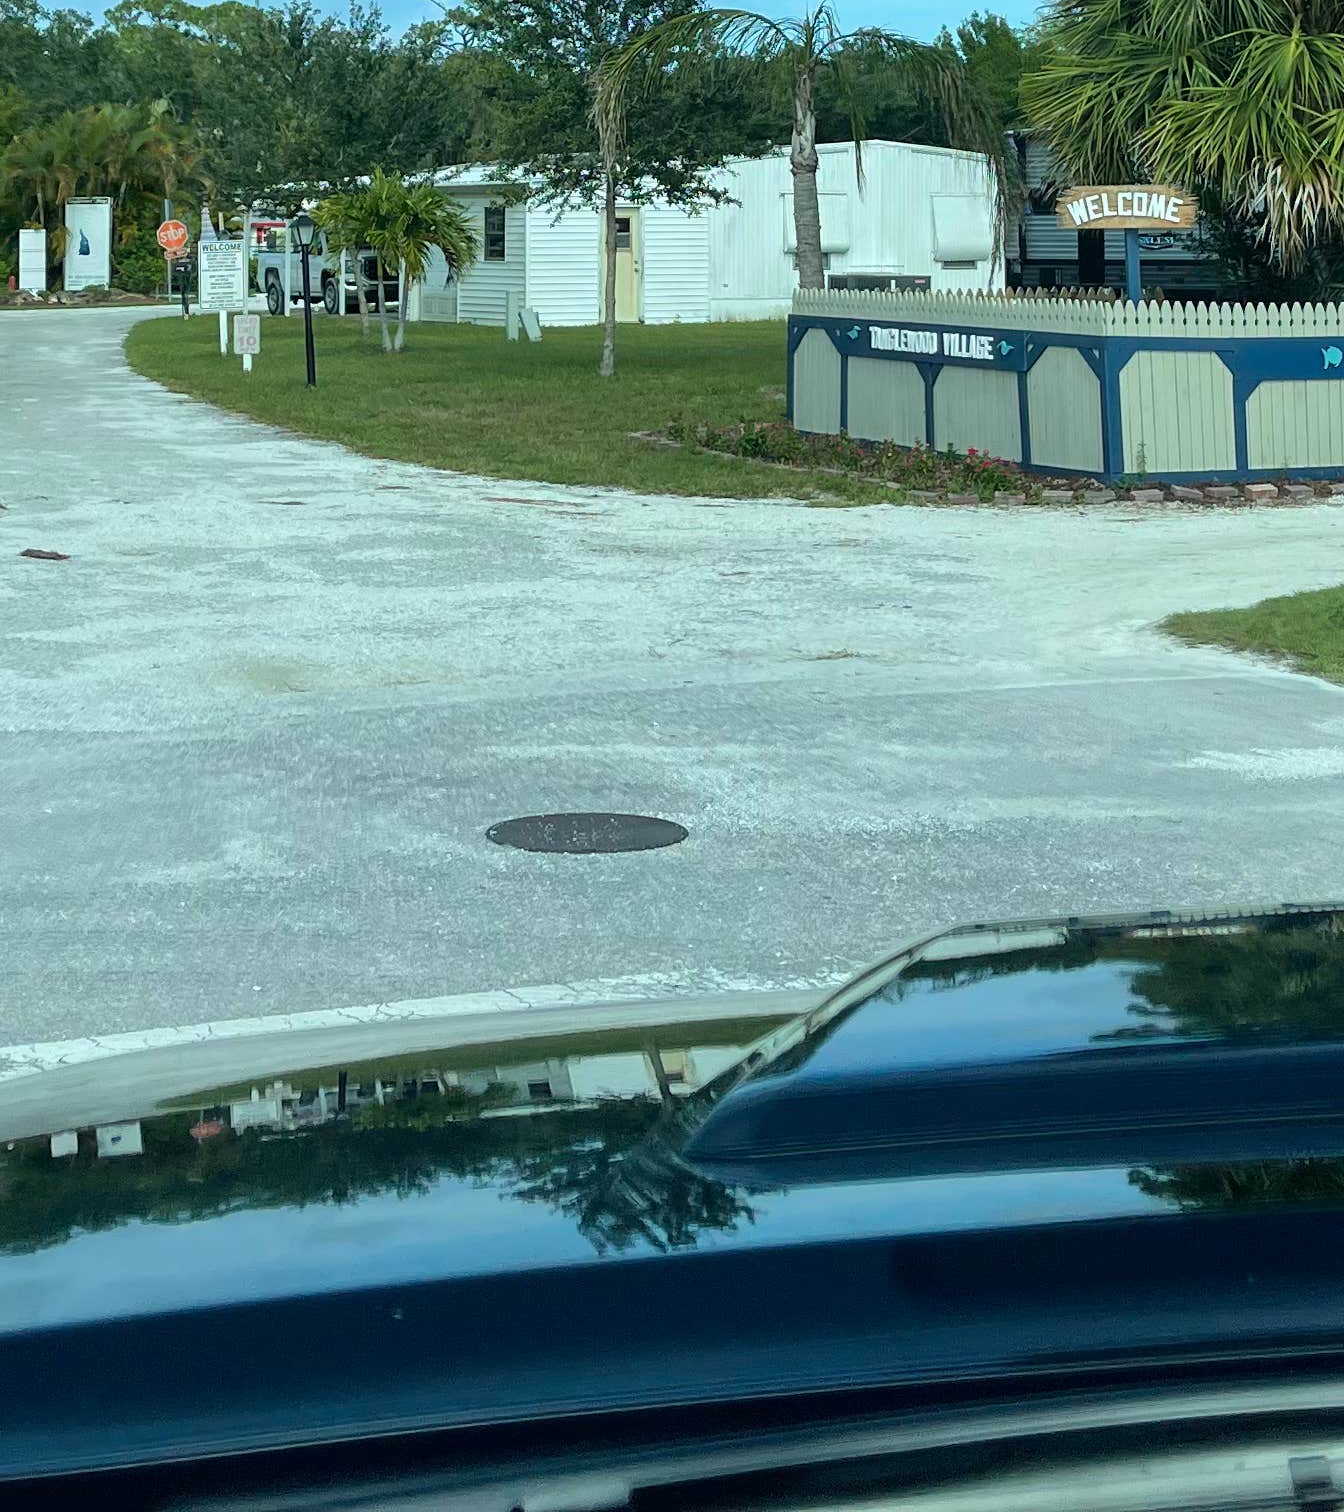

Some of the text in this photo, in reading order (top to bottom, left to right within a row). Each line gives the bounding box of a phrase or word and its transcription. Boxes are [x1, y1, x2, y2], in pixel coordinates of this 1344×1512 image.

[1066, 191, 1184, 226] WELCOME
[159, 227, 185, 243] STOP
[202, 243, 241, 252] WELCOME
[868, 326, 994, 360] TANGLEWOOD VILLAGE
